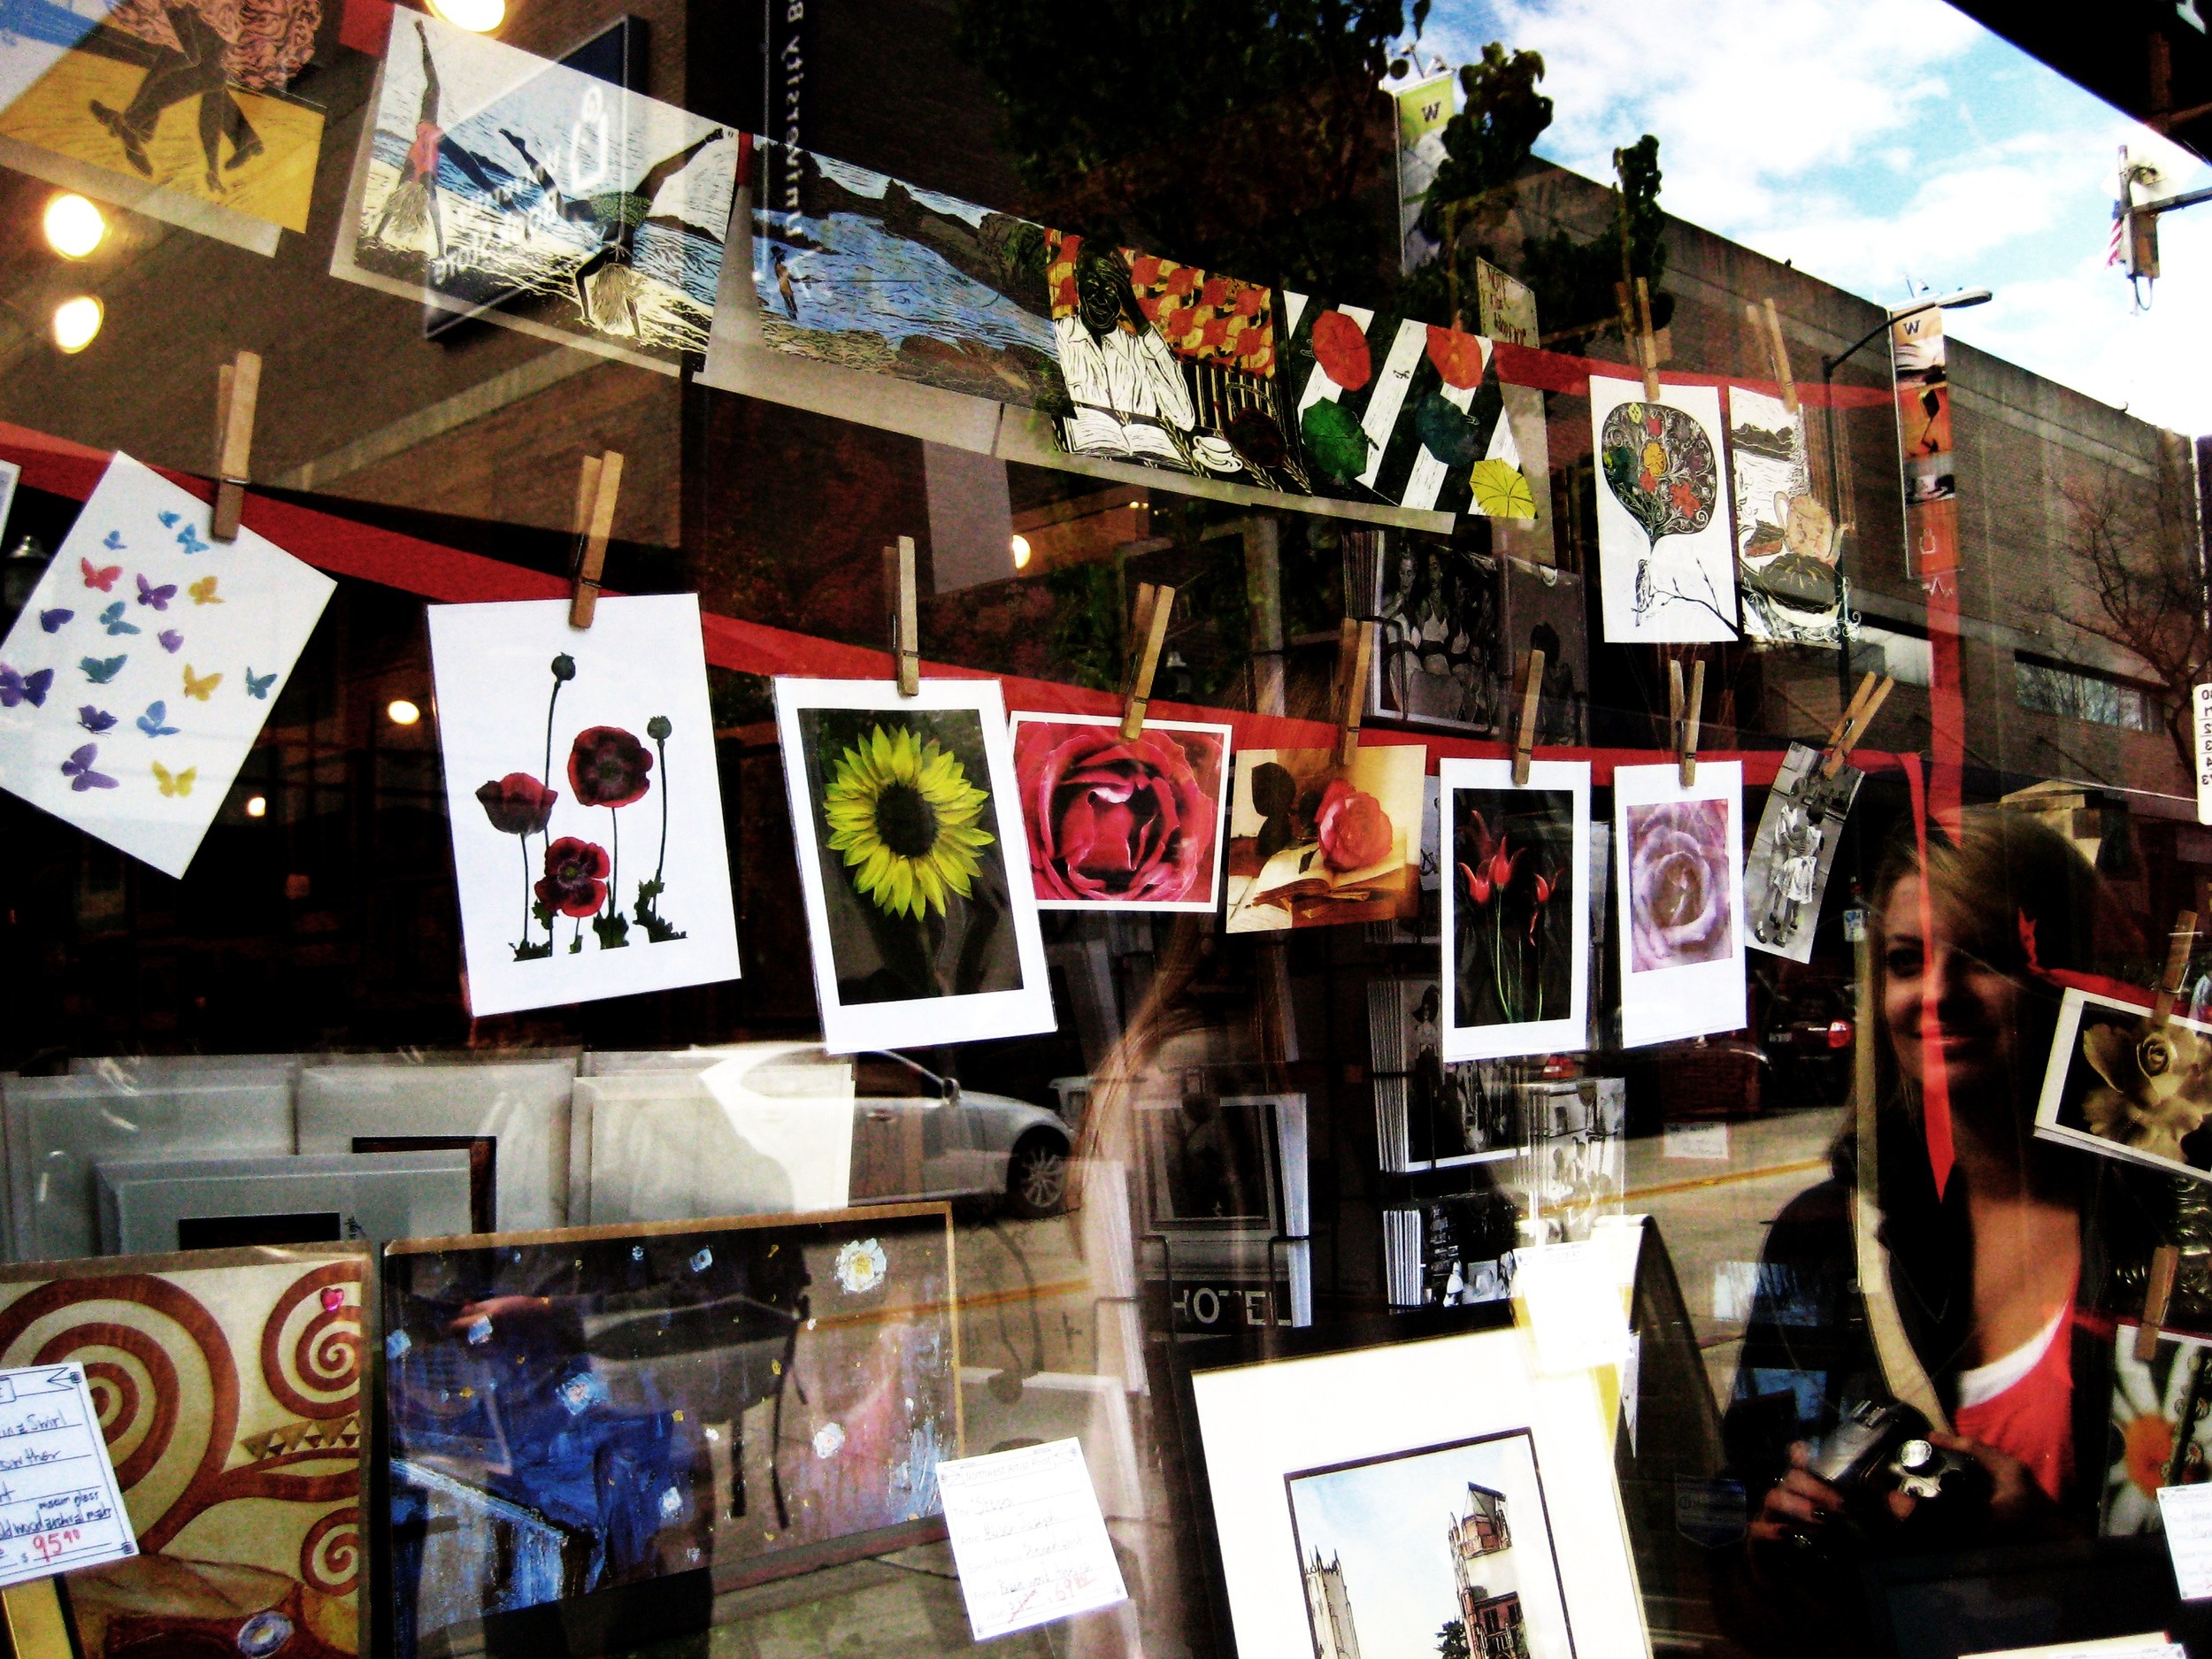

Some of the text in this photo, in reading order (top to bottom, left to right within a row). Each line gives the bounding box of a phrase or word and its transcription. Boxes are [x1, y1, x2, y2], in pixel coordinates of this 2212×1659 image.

[965, 1465, 1005, 1482] Northwest
[1032, 1456, 1052, 1469] Print
[993, 1555, 1023, 1567] Feature
